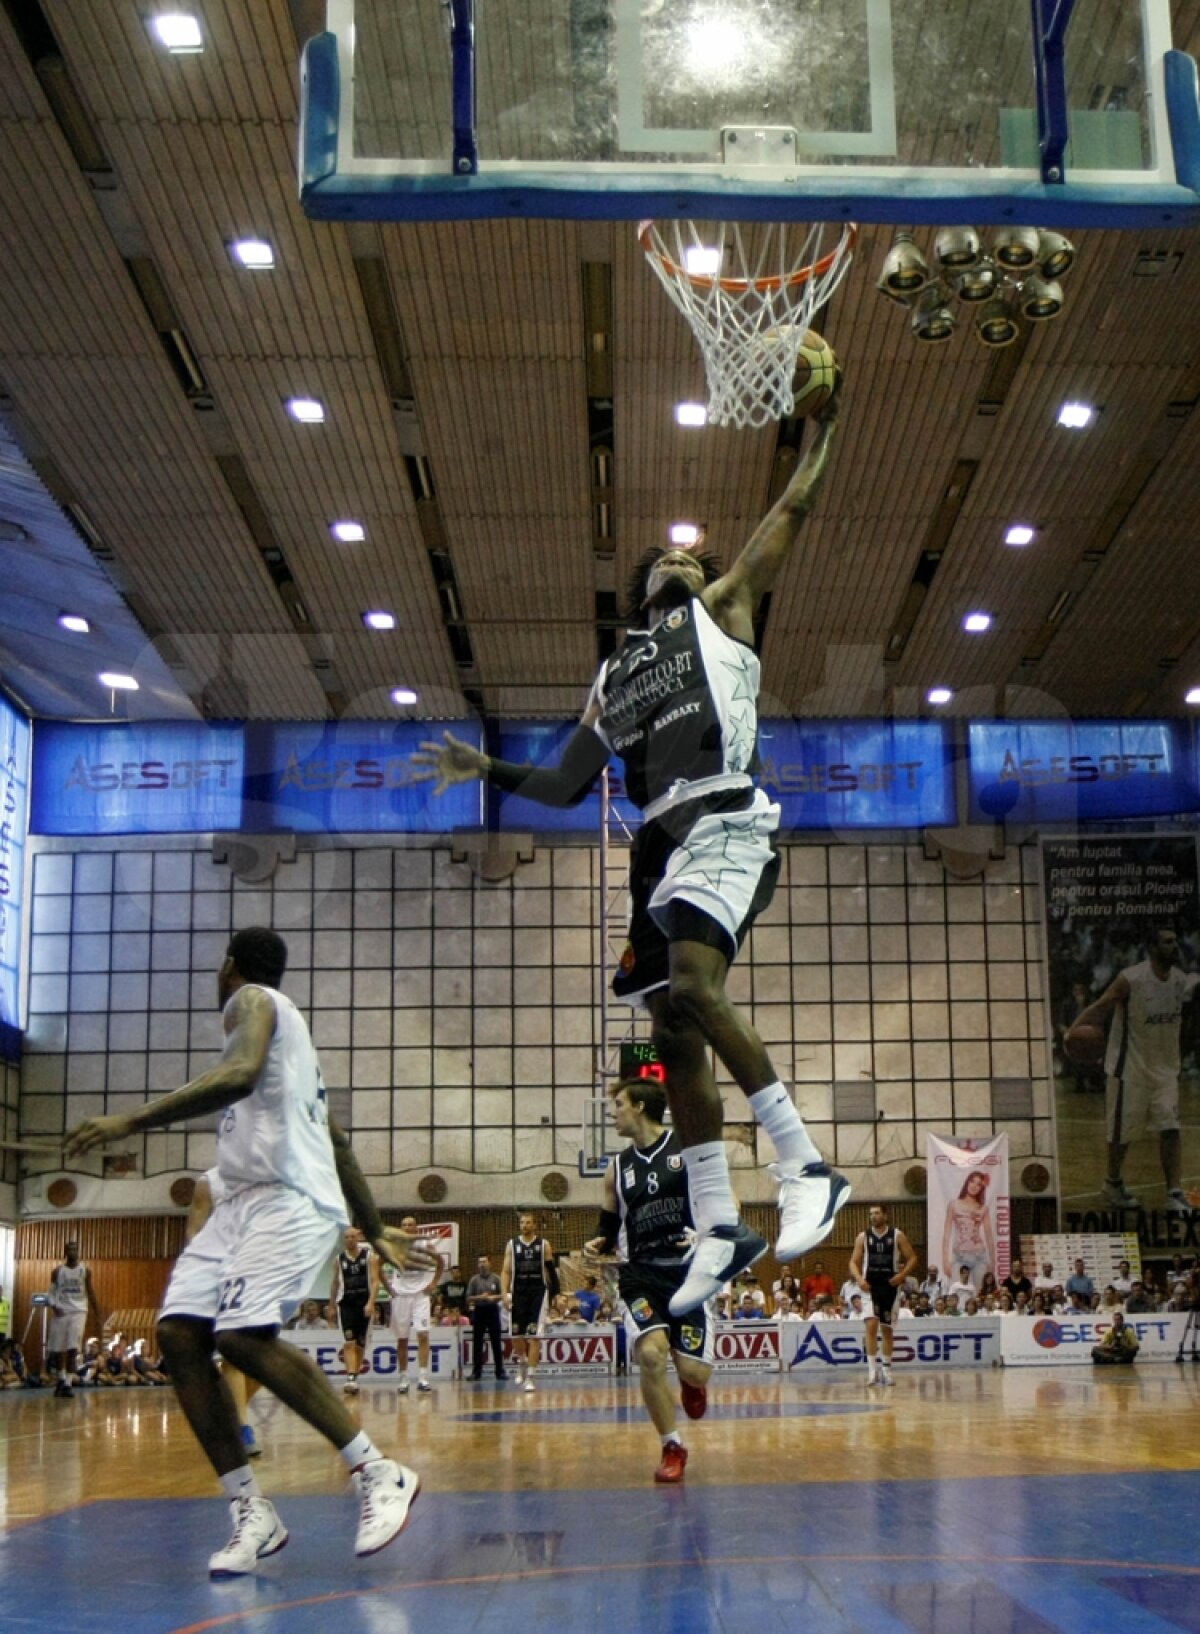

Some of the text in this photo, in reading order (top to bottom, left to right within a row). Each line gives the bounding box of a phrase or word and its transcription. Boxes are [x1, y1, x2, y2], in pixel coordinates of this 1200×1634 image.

[64, 754, 238, 793] ASESOFT
[278, 752, 414, 792] ASESO
[759, 756, 923, 793] ASESOFT
[997, 749, 1163, 787] ASESOFT
[1083, 846, 1122, 860] luptat
[1051, 864, 1177, 881] pentru familia mea,
[1052, 884, 1096, 899] pentru
[1068, 903, 1112, 919] pentru
[633, 1044, 657, 1061] 4:2
[647, 1171, 659, 1194] 8
[1032, 1319, 1172, 1348] ASESFT
